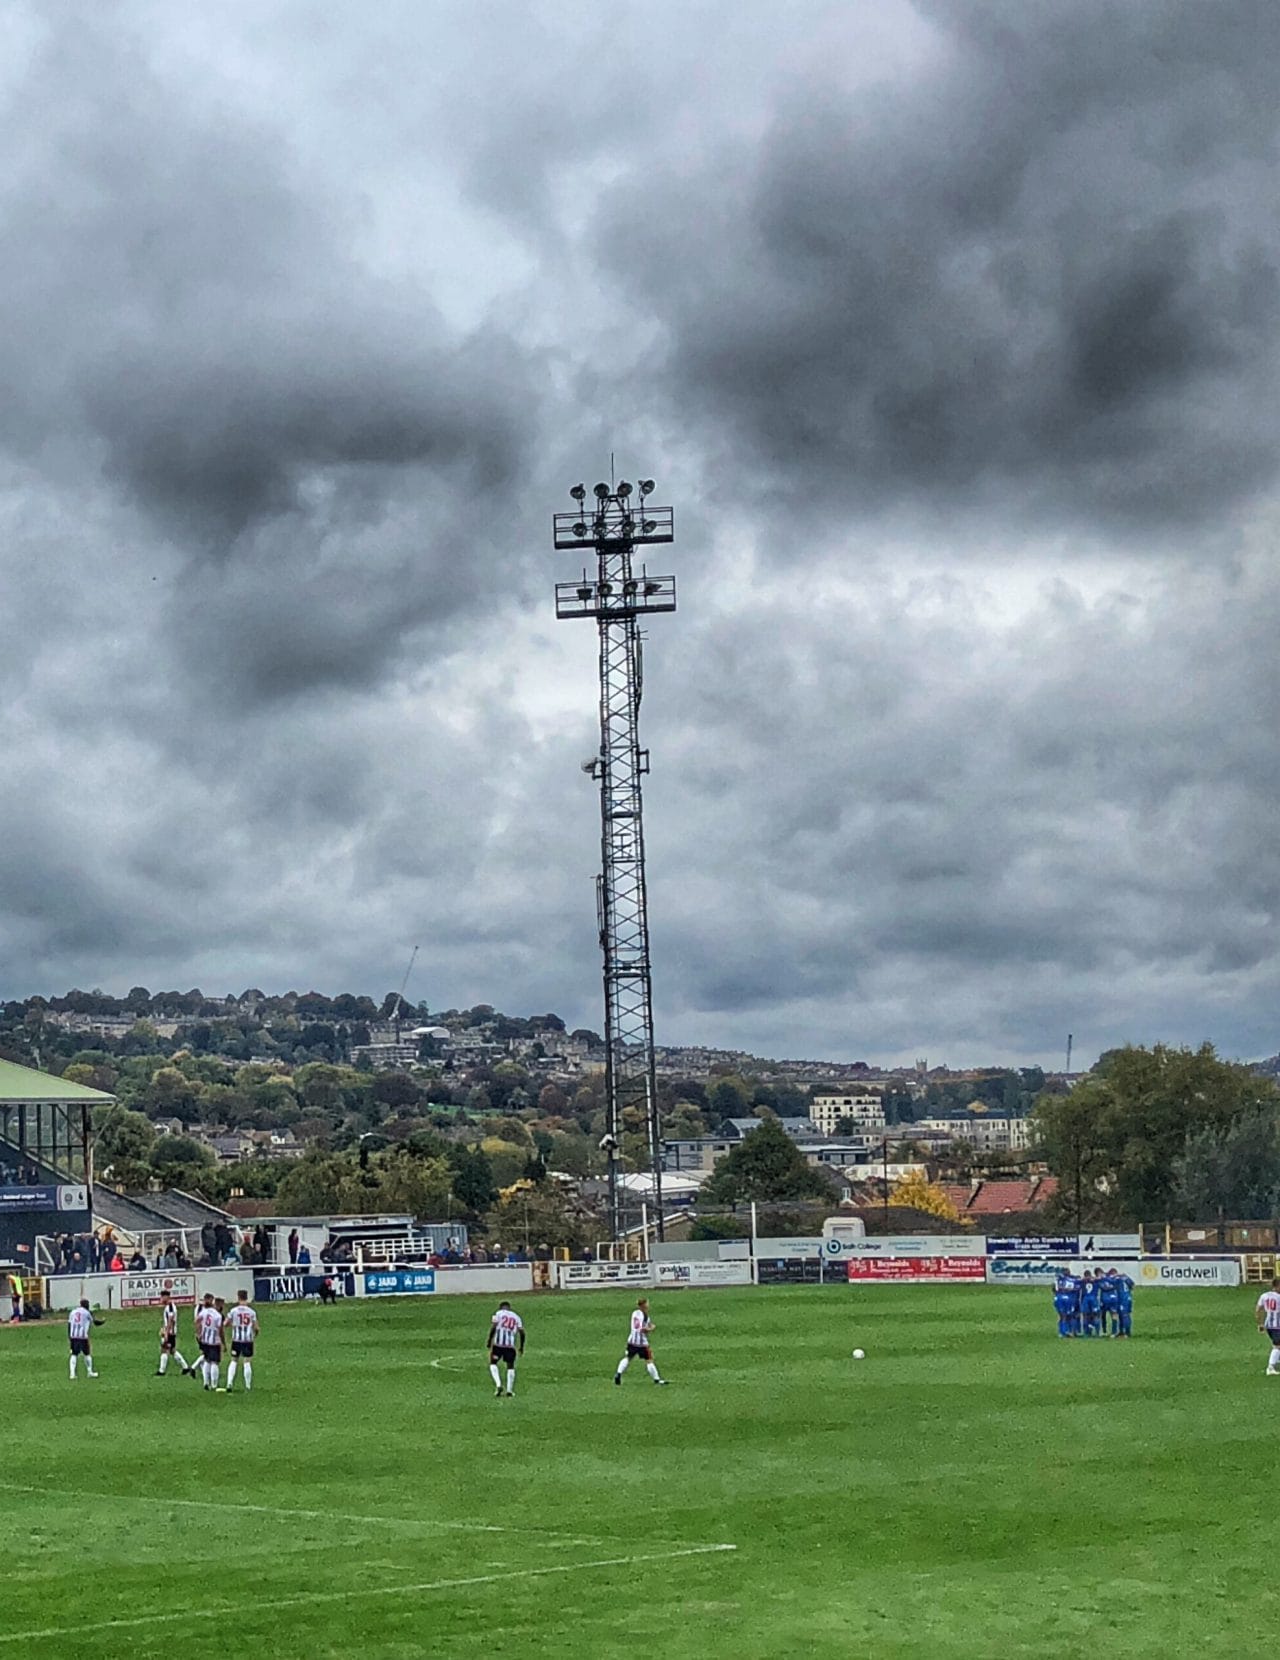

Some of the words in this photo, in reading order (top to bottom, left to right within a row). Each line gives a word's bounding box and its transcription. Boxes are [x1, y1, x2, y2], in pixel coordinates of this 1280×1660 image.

[1161, 1266, 1218, 1279] Gradwell
[1085, 1283, 1093, 1294] 9
[1265, 1299, 1276, 1311] 10
[75, 1312, 81, 1323] 3
[237, 1313, 250, 1326] 15
[502, 1315, 516, 1331] 20
